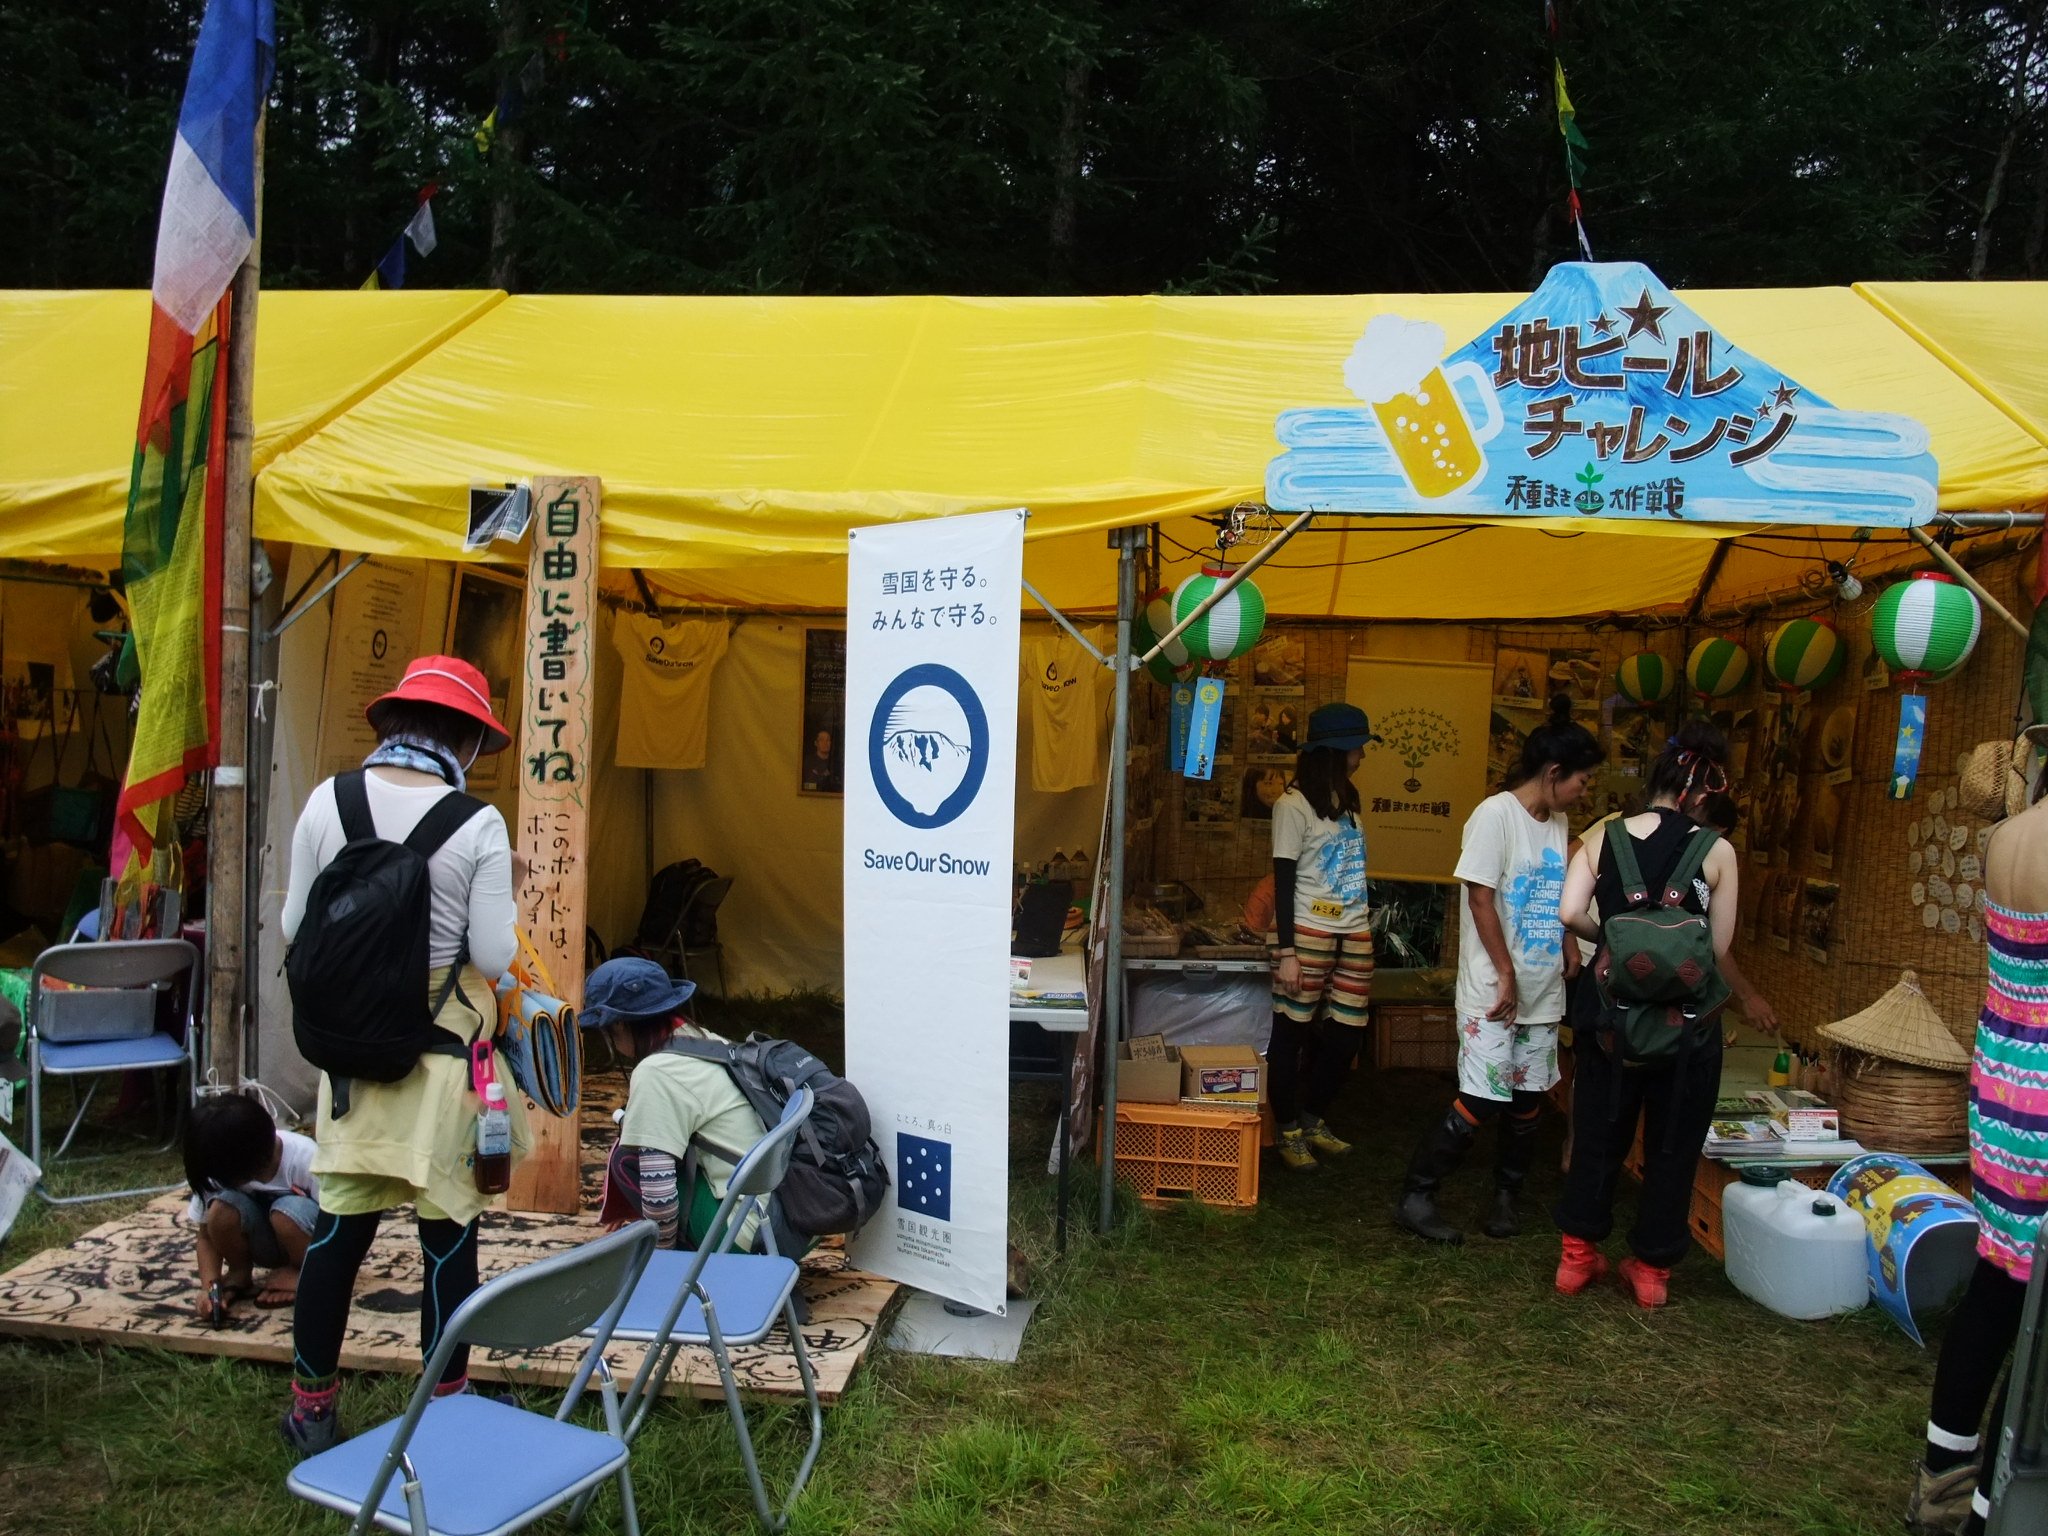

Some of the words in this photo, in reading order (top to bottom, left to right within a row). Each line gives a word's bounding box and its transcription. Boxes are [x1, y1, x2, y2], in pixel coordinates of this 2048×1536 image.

[1493, 292, 1744, 398] 地ビール
[1523, 380, 1800, 467] チャレンジ
[1505, 475, 1572, 511] 種まき
[1609, 476, 1686, 519] 大作戦
[882, 566, 987, 595] 雪国を守る。
[873, 603, 997, 631] みんなで守る。
[529, 488, 580, 782] 自由に書いてね
[864, 848, 904, 871] Save
[904, 850, 937, 873] Our
[938, 852, 990, 876] Snow
[551, 812, 575, 960] このボードは、
[1529, 889, 1560, 900] CHANGE
[1536, 880, 1564, 890] CLIMAT
[1525, 904, 1560, 916] BIODIVER
[896, 1114, 952, 1135] こころ、真っ白
[897, 1217, 952, 1245] 雪国観光圏
